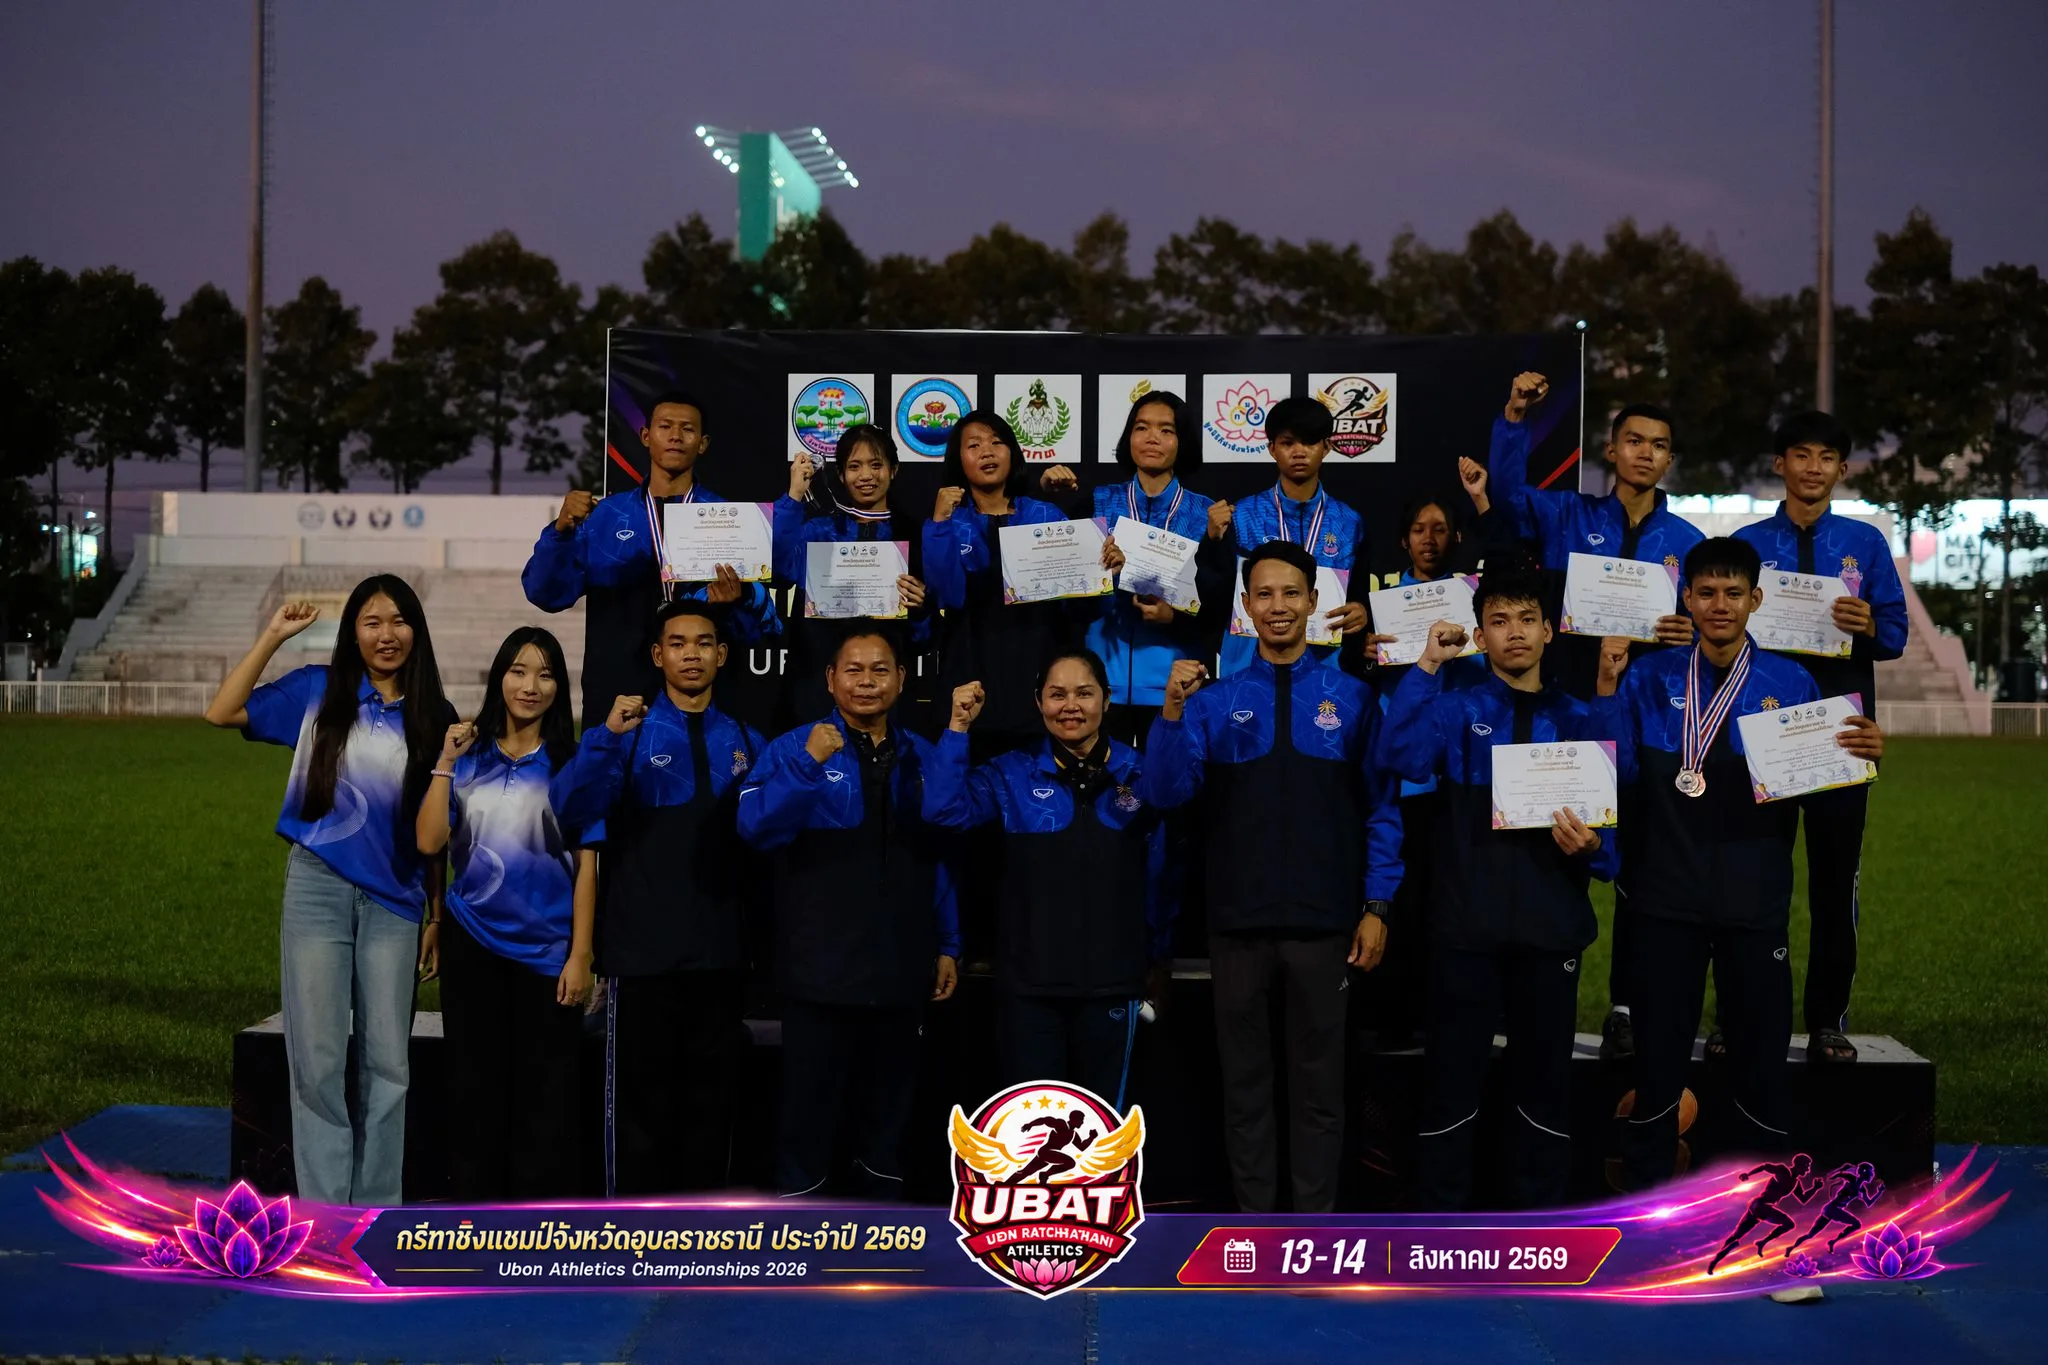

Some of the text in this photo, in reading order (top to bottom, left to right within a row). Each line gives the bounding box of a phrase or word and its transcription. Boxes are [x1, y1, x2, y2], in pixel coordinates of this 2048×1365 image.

[1203, 421, 1268, 454] มูลนิธิกีฬาจังหวัดอุบ
